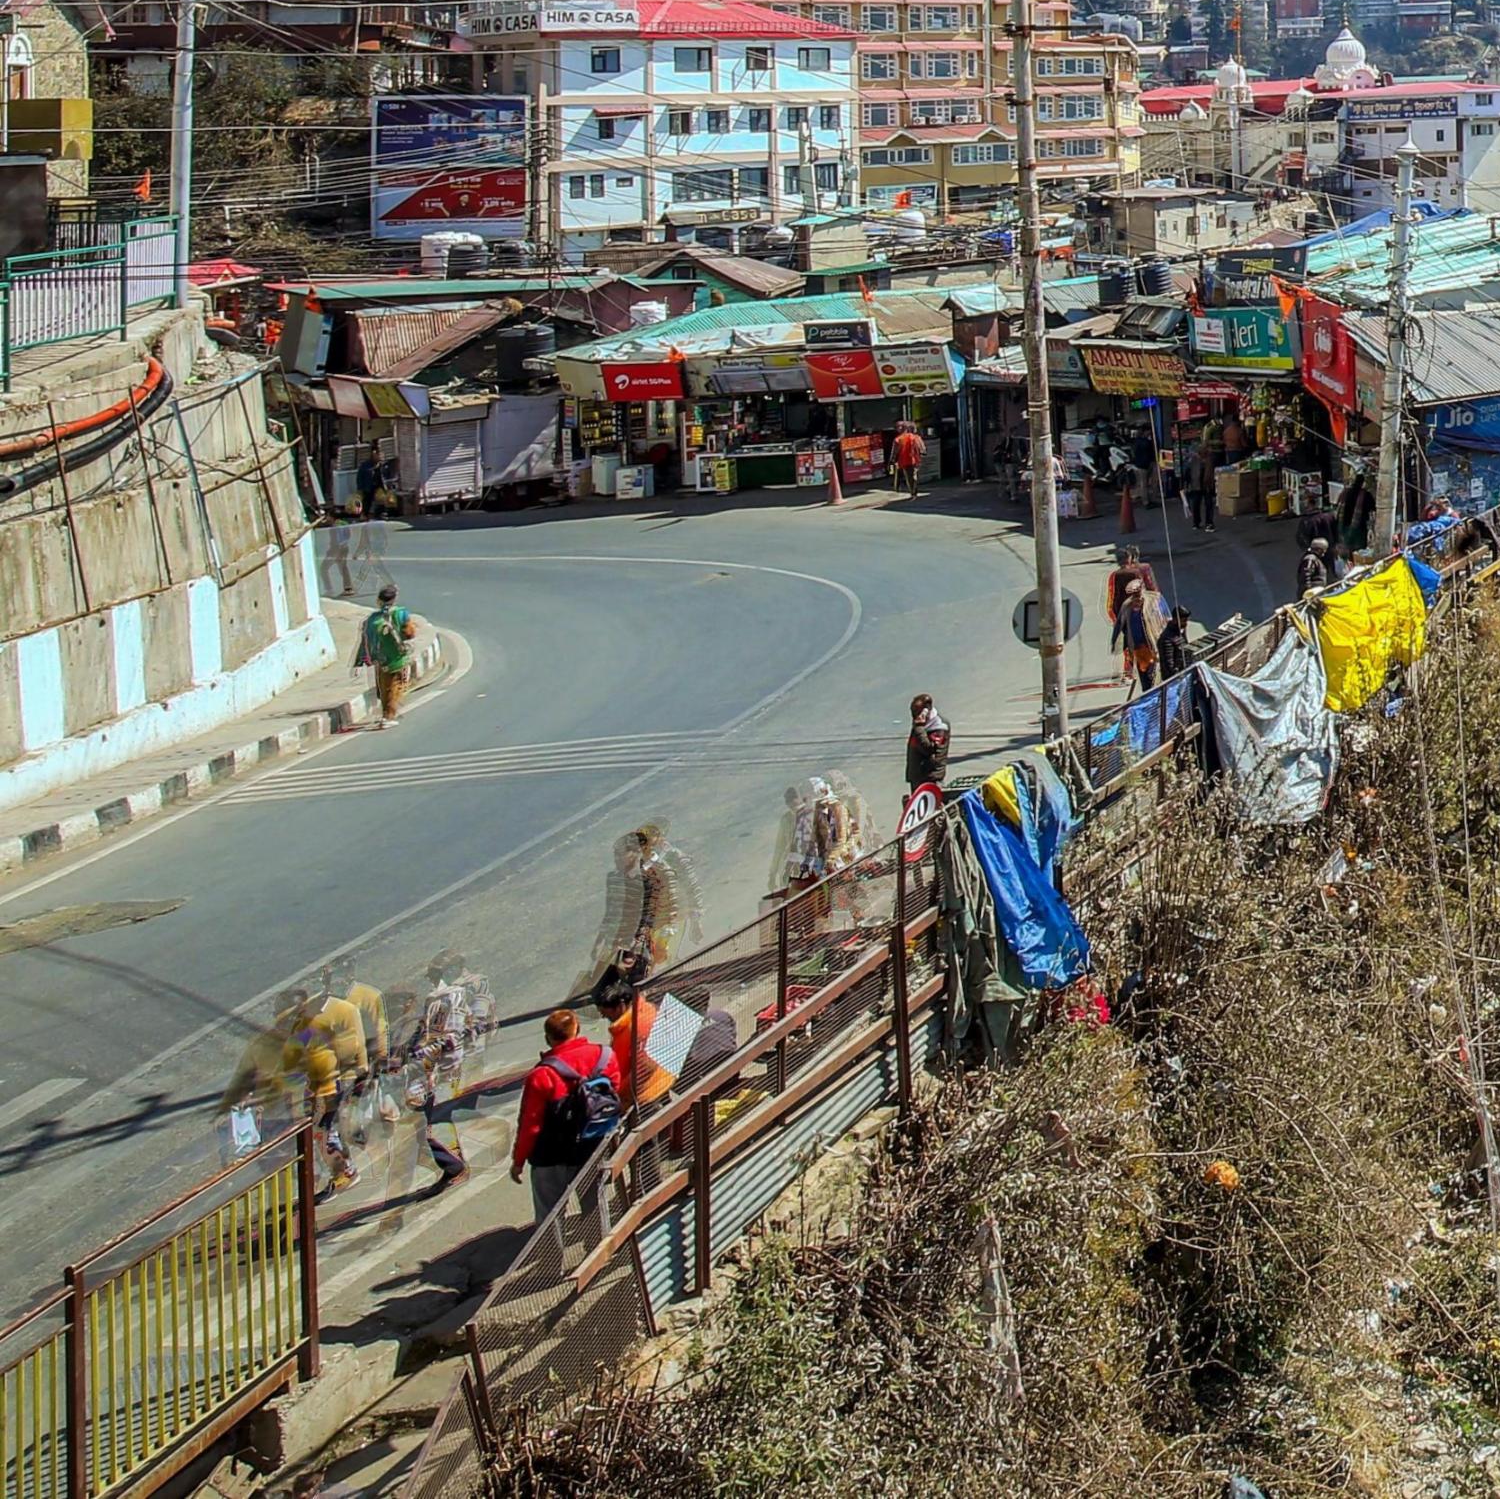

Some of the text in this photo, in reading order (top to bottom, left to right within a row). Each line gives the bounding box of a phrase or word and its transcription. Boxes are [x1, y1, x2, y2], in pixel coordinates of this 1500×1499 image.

[471, 15, 538, 34] HIM CASA
[546, 12, 635, 23] HIM CASA
[1091, 348, 1143, 369] AMRIT
[1444, 406, 1474, 429] Jio
